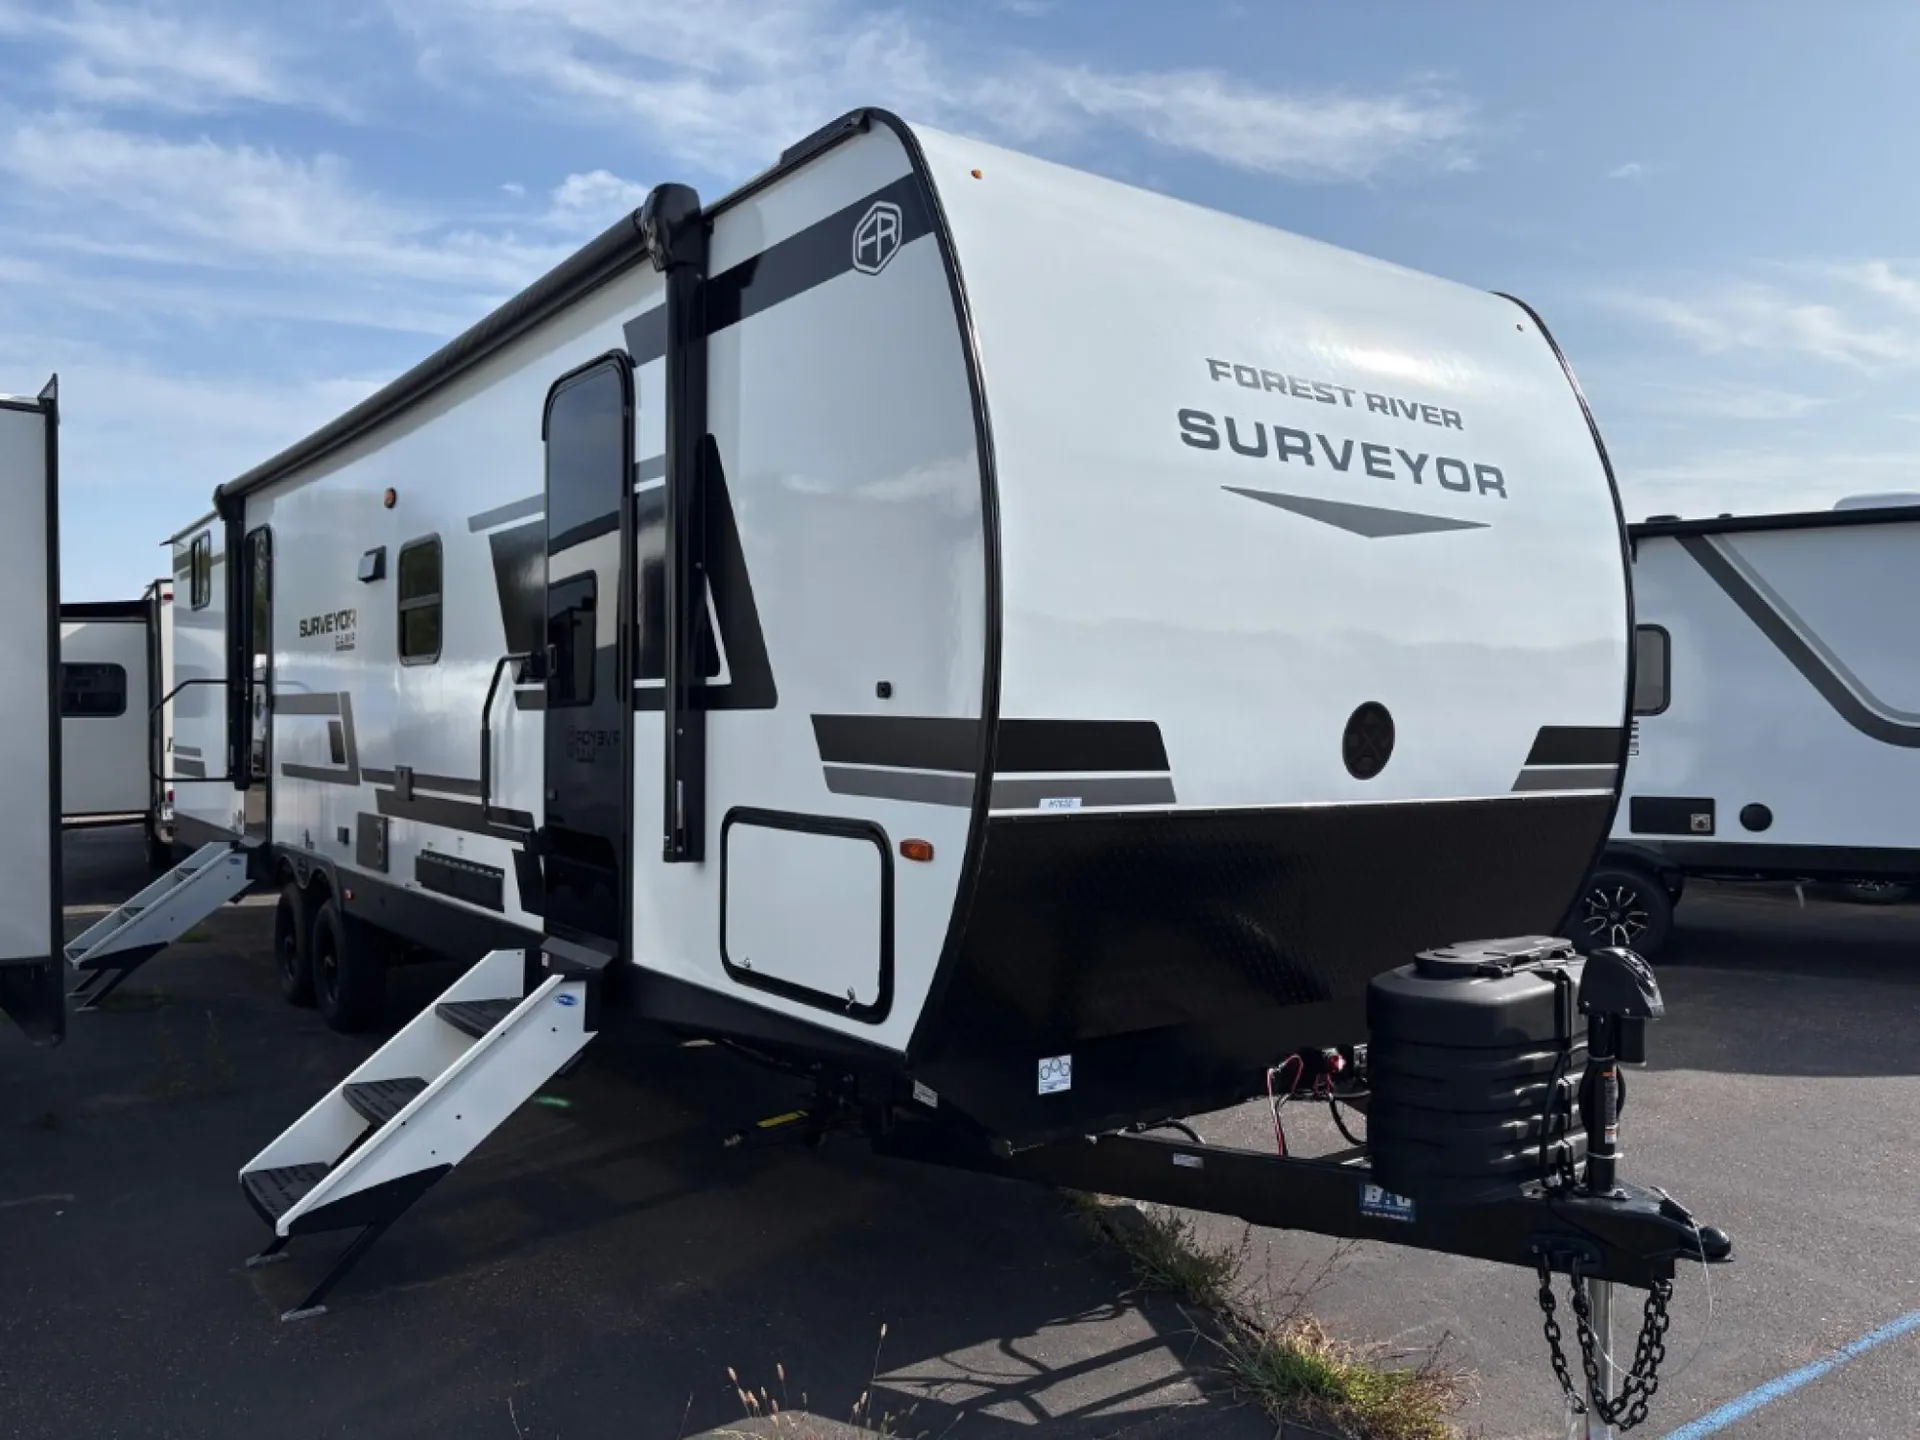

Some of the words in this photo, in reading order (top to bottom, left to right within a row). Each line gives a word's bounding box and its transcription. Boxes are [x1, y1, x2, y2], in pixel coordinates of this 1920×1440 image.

[1206, 357, 1356, 408] FOREST
[1364, 391, 1464, 431] RIVER
[1178, 408, 1508, 499] SURVEYOR
[299, 608, 357, 638] SURVEYOR
